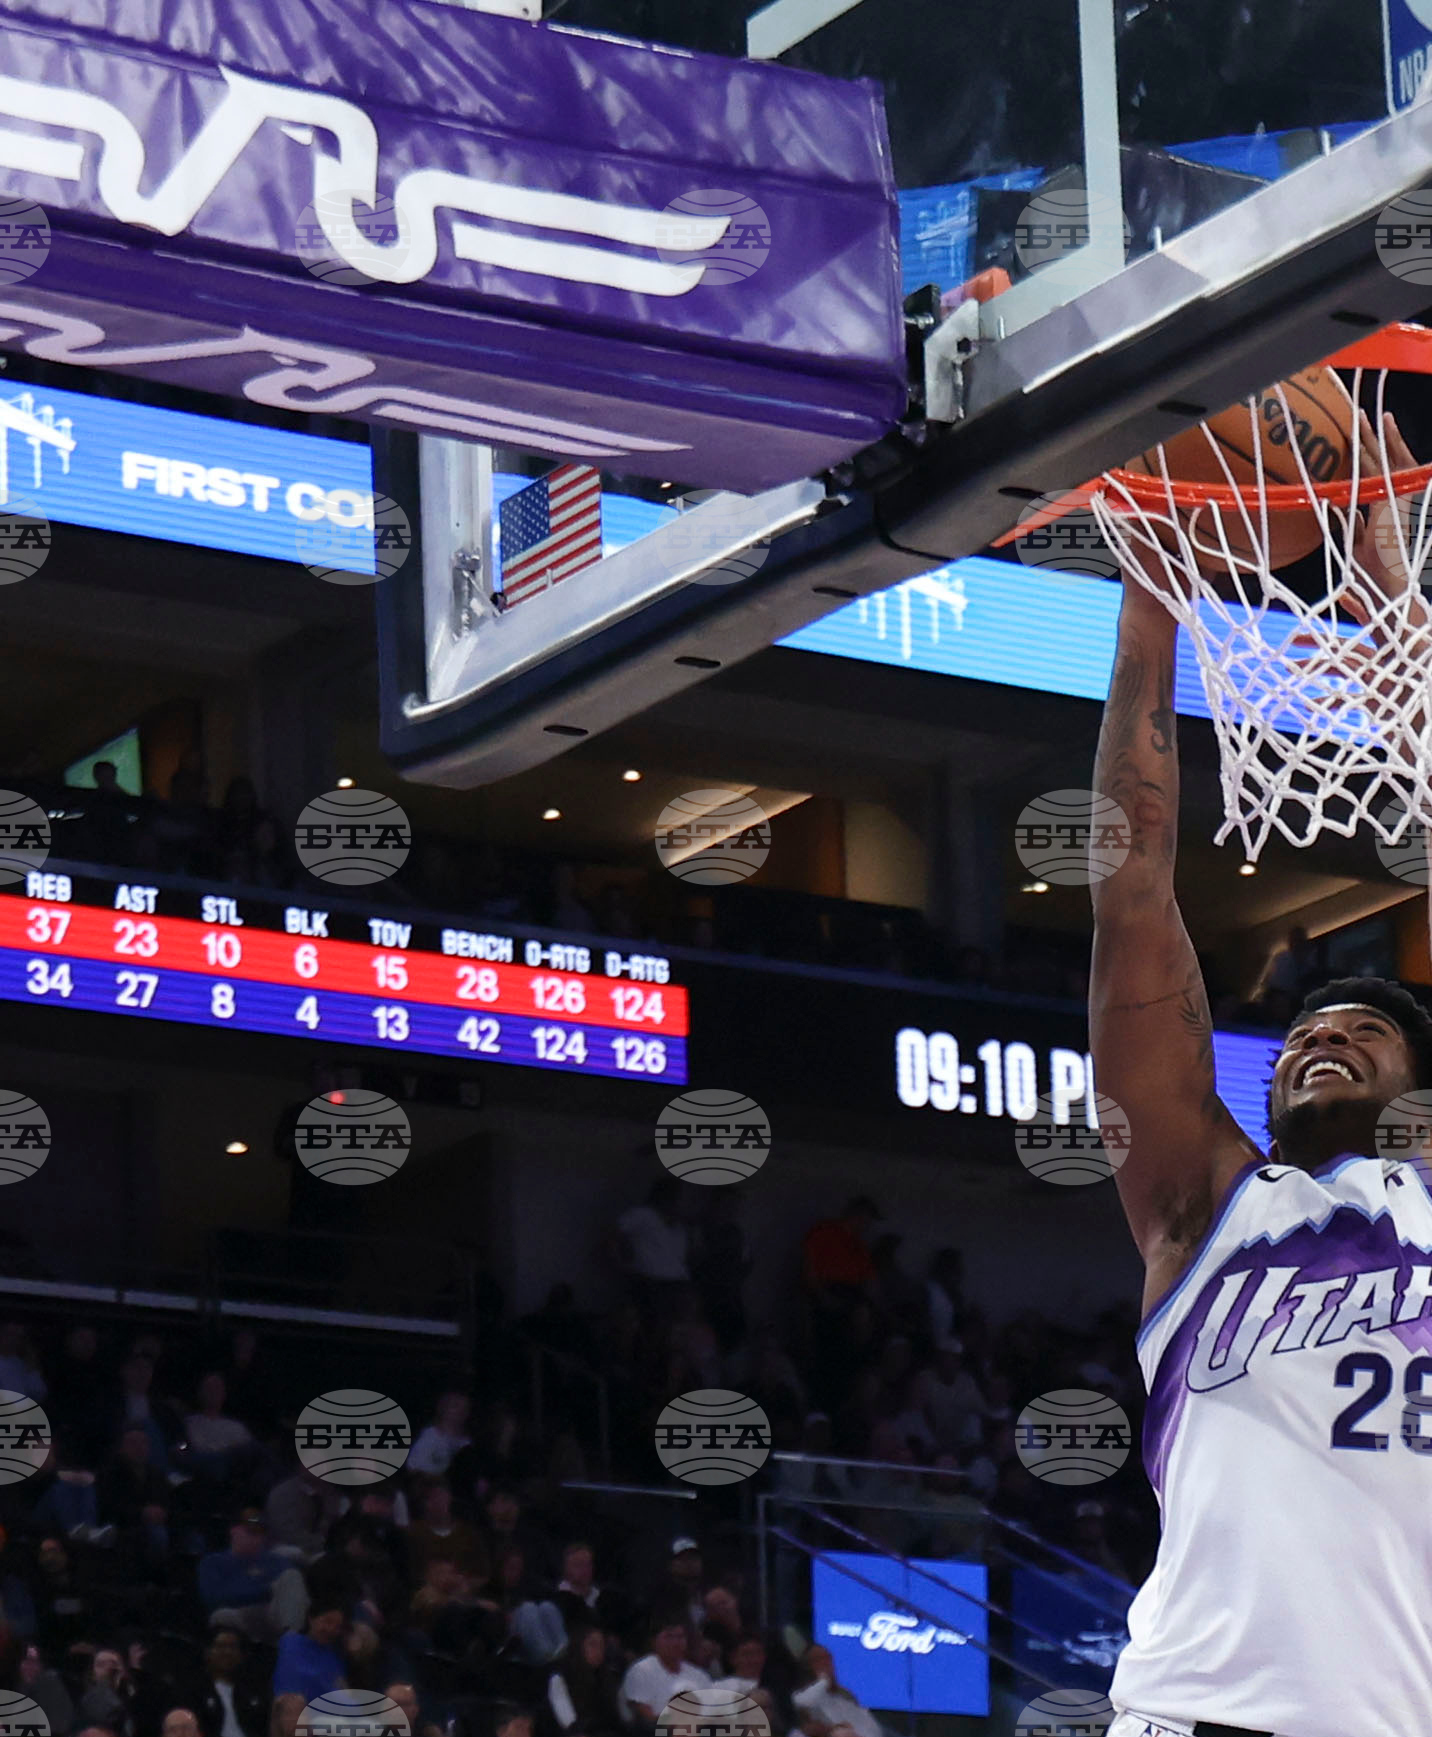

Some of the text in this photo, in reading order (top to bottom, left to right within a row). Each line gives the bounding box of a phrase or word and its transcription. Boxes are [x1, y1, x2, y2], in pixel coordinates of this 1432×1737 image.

[122, 451, 375, 530] FIRST CO
[26, 871, 71, 902] REB
[114, 884, 159, 914] AST
[202, 896, 243, 926] STL
[284, 906, 329, 937] BLK
[368, 918, 412, 949] TOV
[441, 929, 513, 963] BENCH
[27, 907, 665, 1024] 37 23 10 6 15 28 126 124
[26, 959, 667, 1074] 34 27 8 4 13 42 124 126
[896, 1027, 1038, 1121] 09:10
[861, 1611, 937, 1654] Ford
